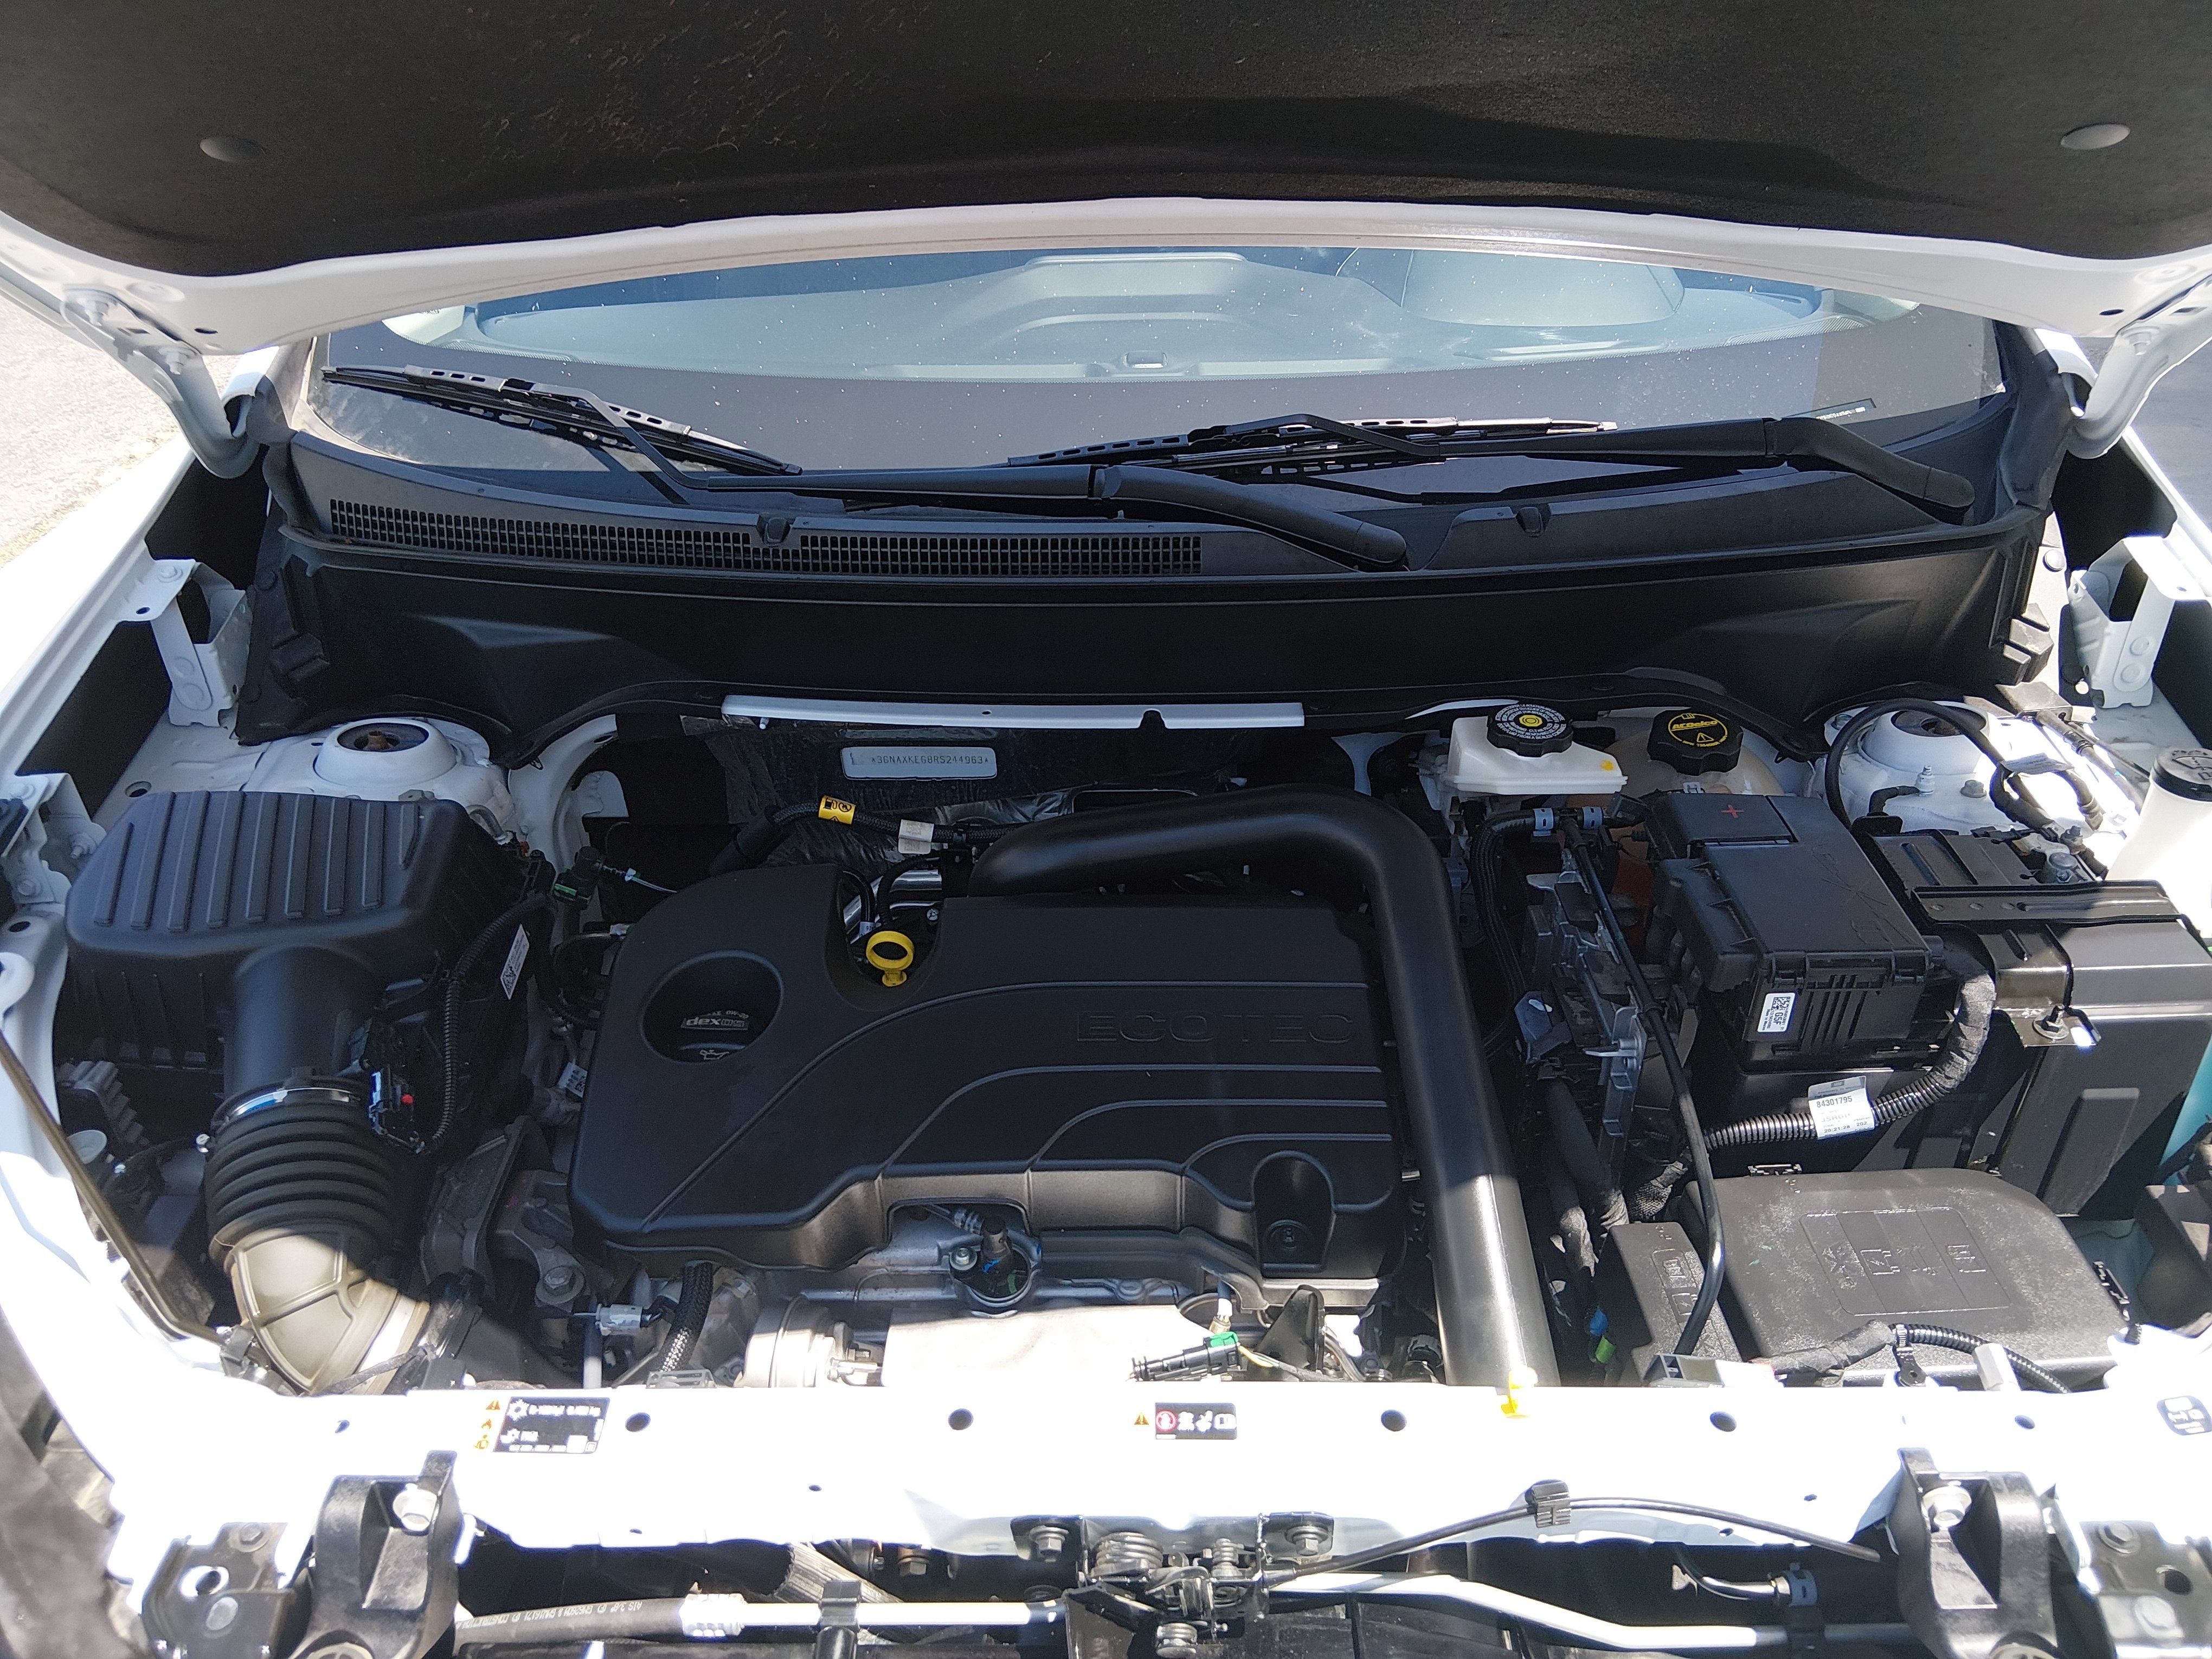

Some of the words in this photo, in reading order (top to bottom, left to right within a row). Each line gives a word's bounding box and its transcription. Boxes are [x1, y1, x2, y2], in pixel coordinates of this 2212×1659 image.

[1672, 721, 1718, 729] ACDelco
[686, 1017, 745, 1027] dexos
[1773, 1012, 1783, 1025] G5F
[1077, 1011, 1354, 1043] ECOTEC
[1816, 1095, 1853, 1108] 84301795
[1824, 1125, 1850, 1133] 20:21:28
